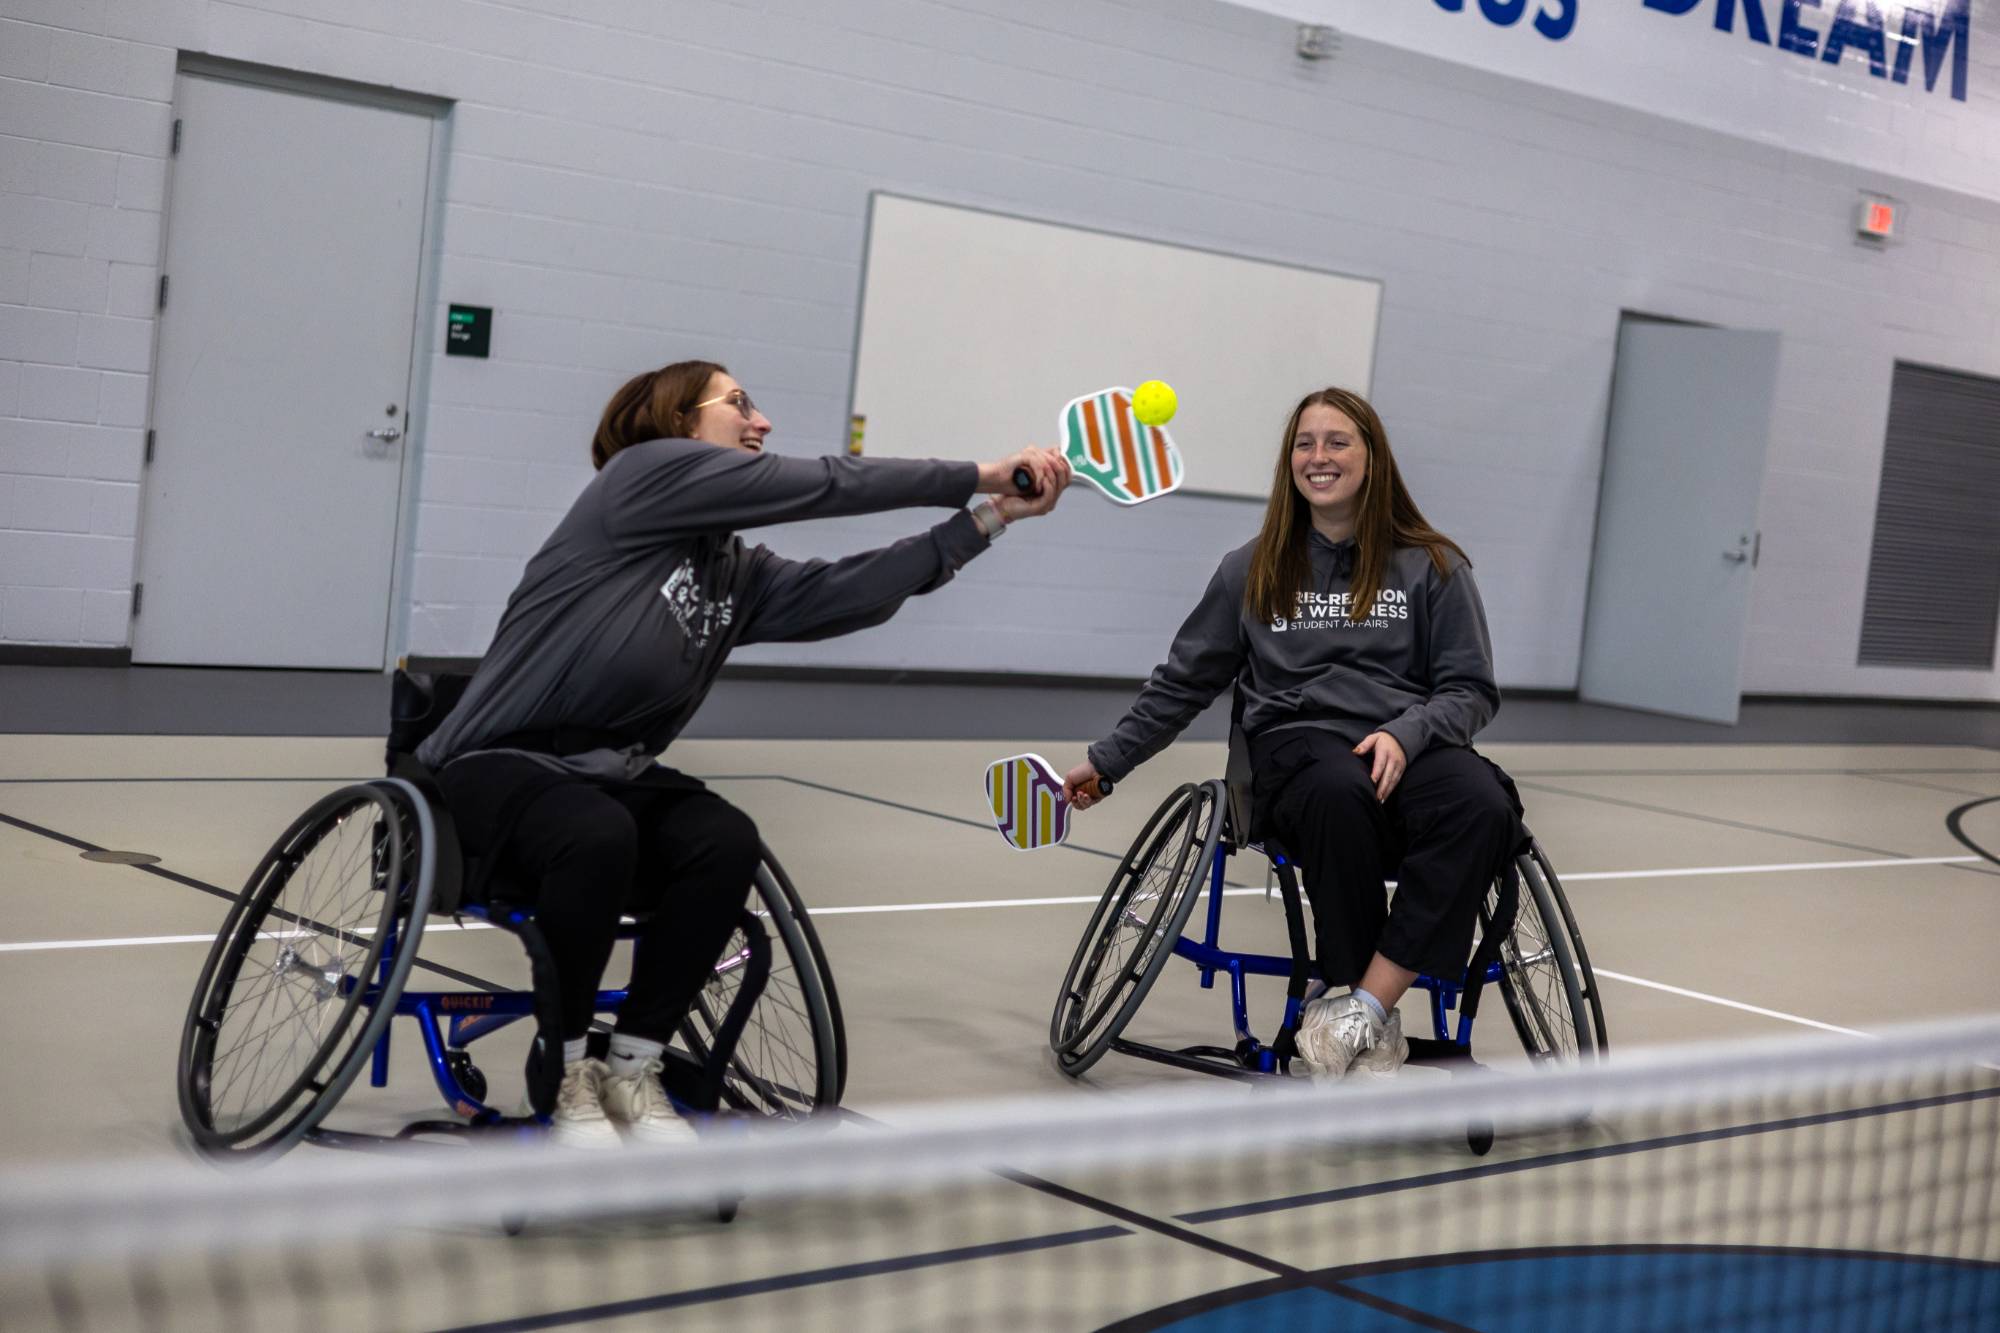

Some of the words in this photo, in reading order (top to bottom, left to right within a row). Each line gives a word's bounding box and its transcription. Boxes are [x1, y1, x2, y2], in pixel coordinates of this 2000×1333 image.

[1642, 0, 1970, 102] EAM
[1295, 589, 1407, 605] RECREION
[1308, 604, 1408, 619] WELESS
[1291, 620, 1340, 630] STUDENT
[1343, 619, 1389, 629] AFFAIRS
